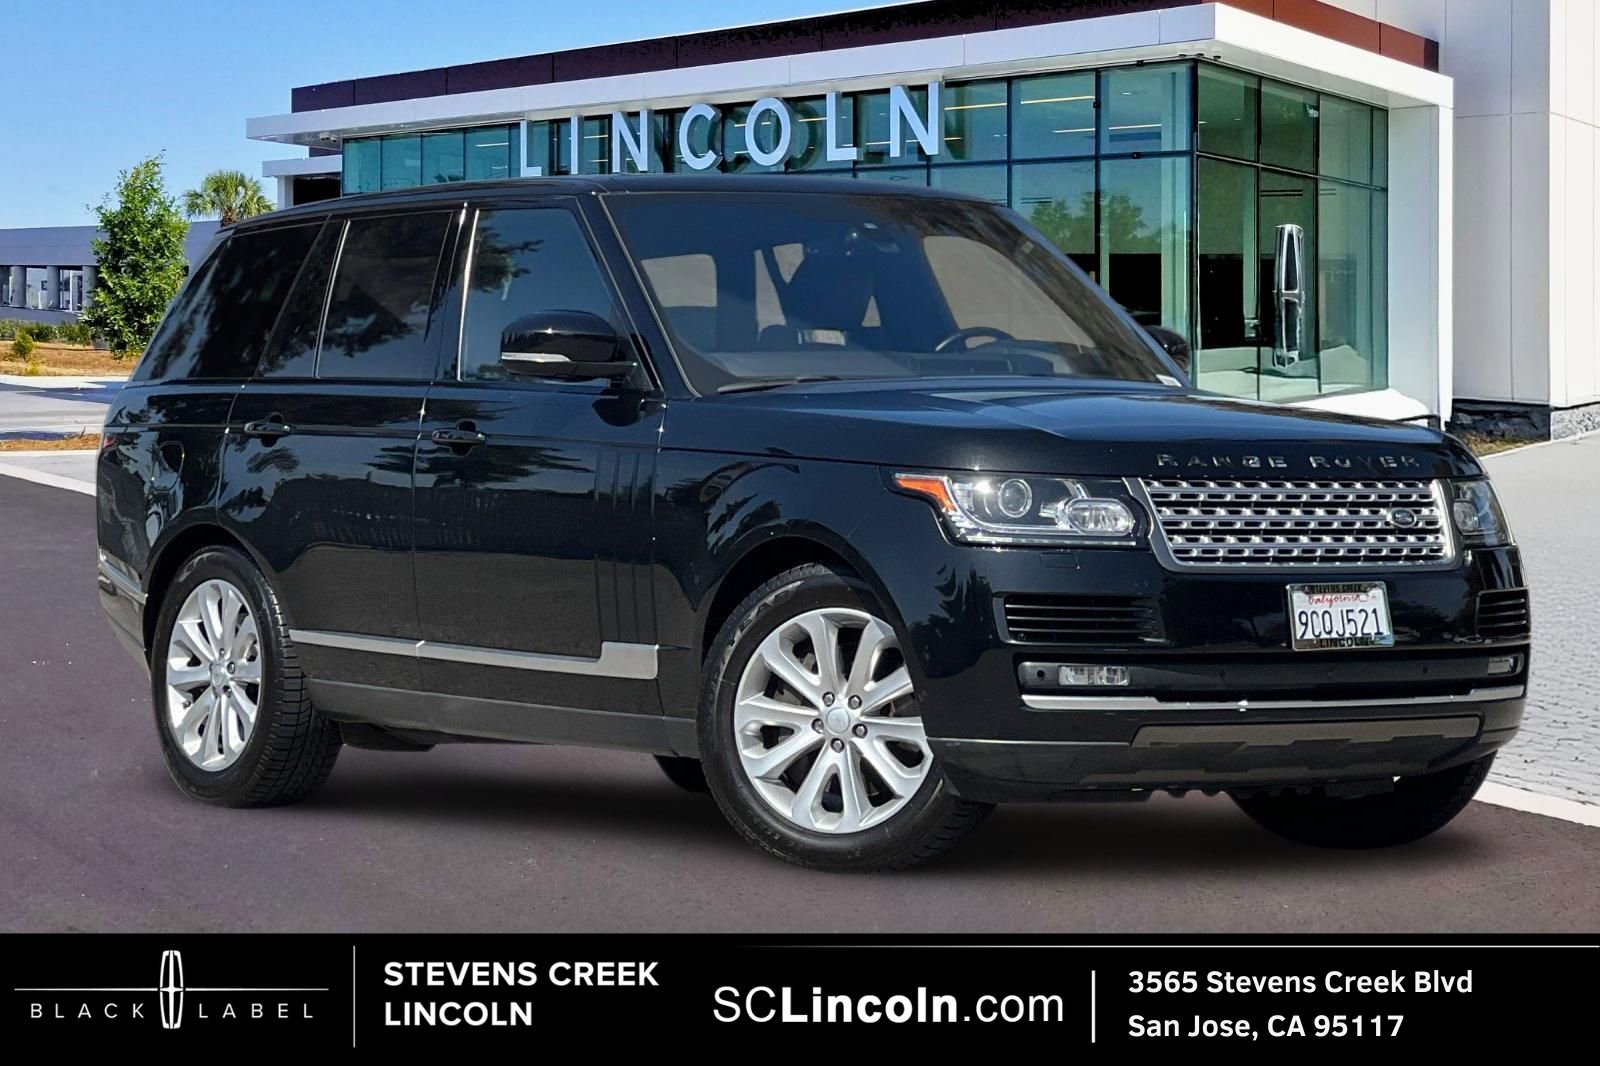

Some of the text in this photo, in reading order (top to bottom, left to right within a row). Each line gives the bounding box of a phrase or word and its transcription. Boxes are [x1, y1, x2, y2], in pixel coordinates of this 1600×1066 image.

[520, 80, 943, 177] LINCOLN
[1156, 453, 1420, 470] RANGE ROVER
[1308, 594, 1367, 608] California
[1298, 607, 1384, 640] 9CQJ521
[1320, 637, 1373, 649] LINCOLN
